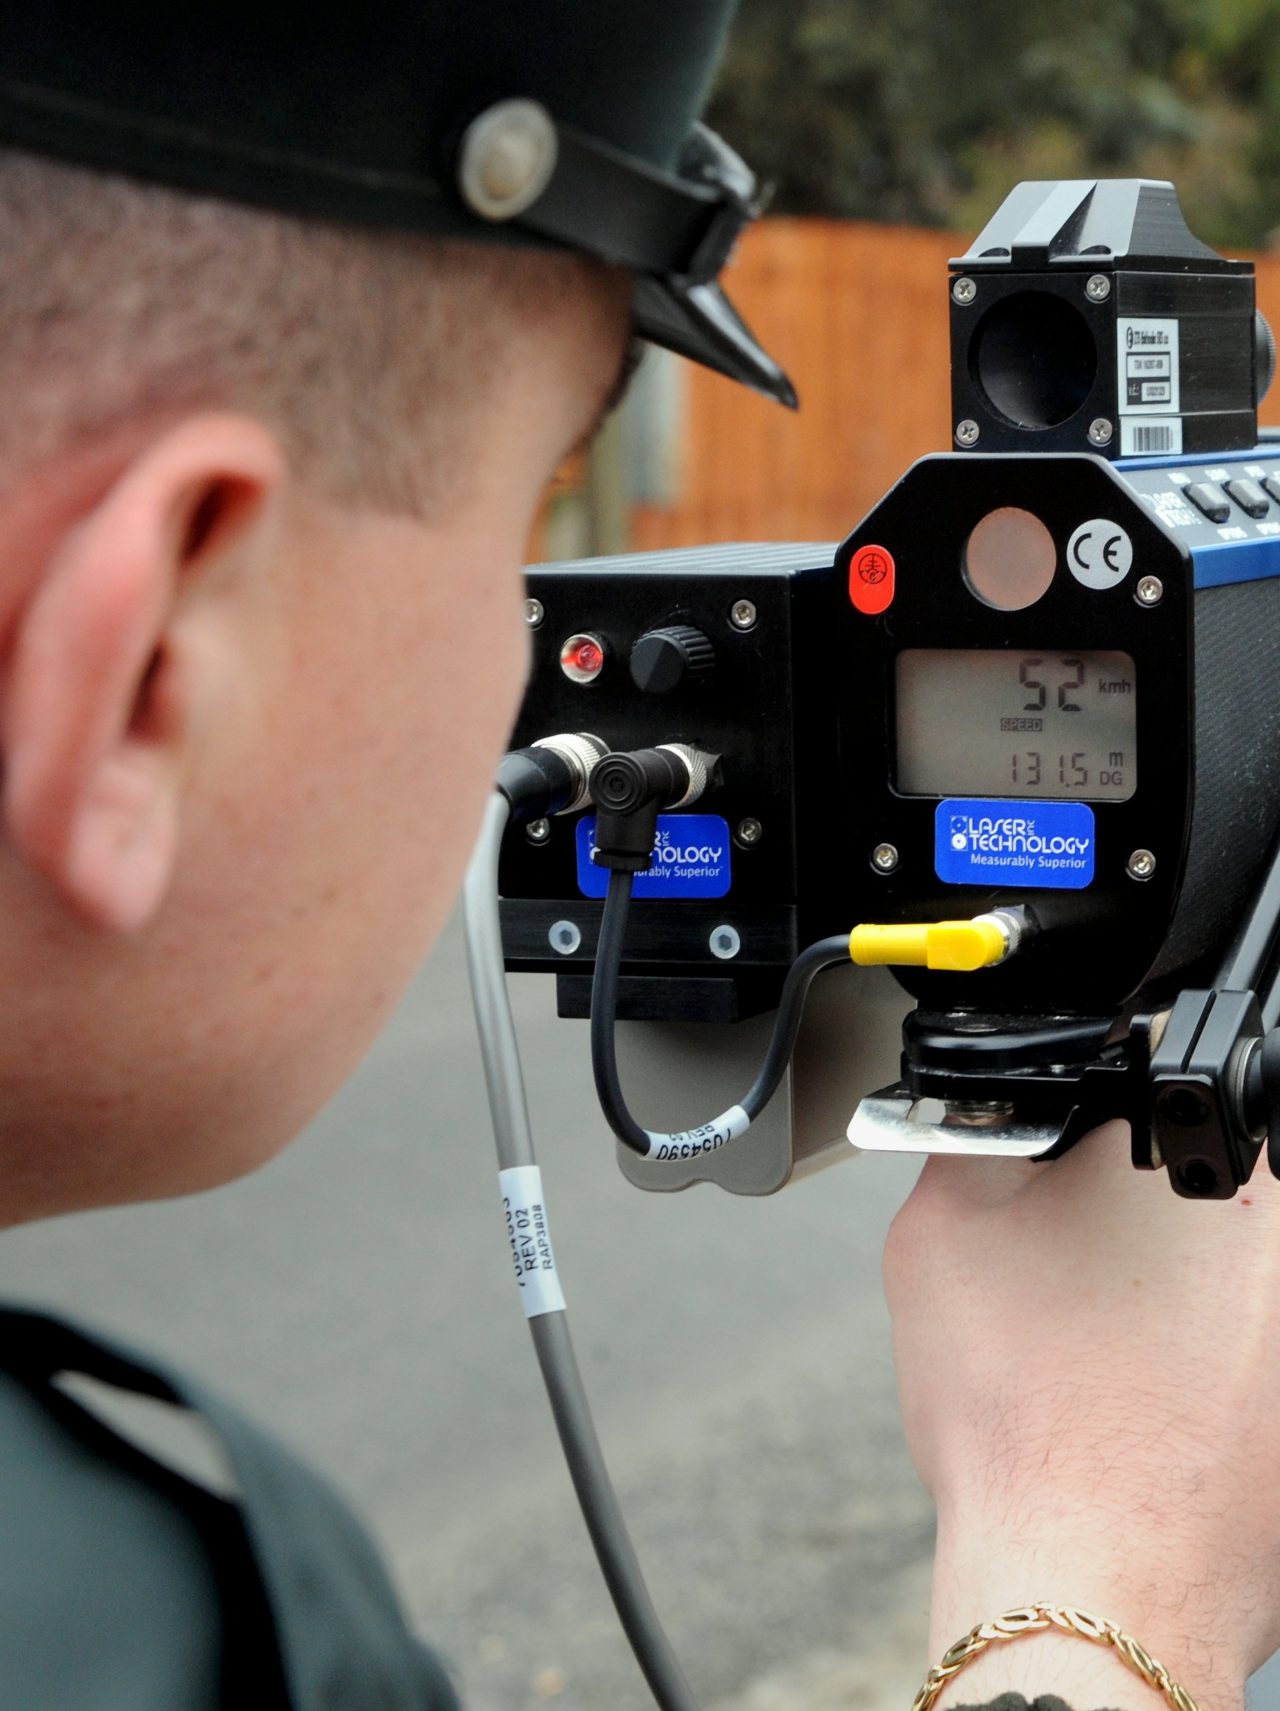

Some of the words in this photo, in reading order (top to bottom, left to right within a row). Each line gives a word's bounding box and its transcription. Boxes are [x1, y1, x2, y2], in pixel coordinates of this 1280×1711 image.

[1019, 658, 1086, 712] 52
[1098, 679, 1132, 694] kmh
[1001, 718, 1043, 732] SPEED
[1012, 752, 1089, 788] 131.5
[1109, 751, 1124, 767] m
[1099, 771, 1124, 786] DG
[968, 817, 1027, 836] LASER
[968, 834, 1090, 854] TECHNOLOGY
[649, 846, 722, 864] NOLOGY
[970, 853, 1036, 869] Measurably
[1038, 855, 1087, 870] Superior
[674, 865, 720, 879] Superior
[515, 1207, 530, 1229] 02
[520, 1234, 539, 1272] REV
